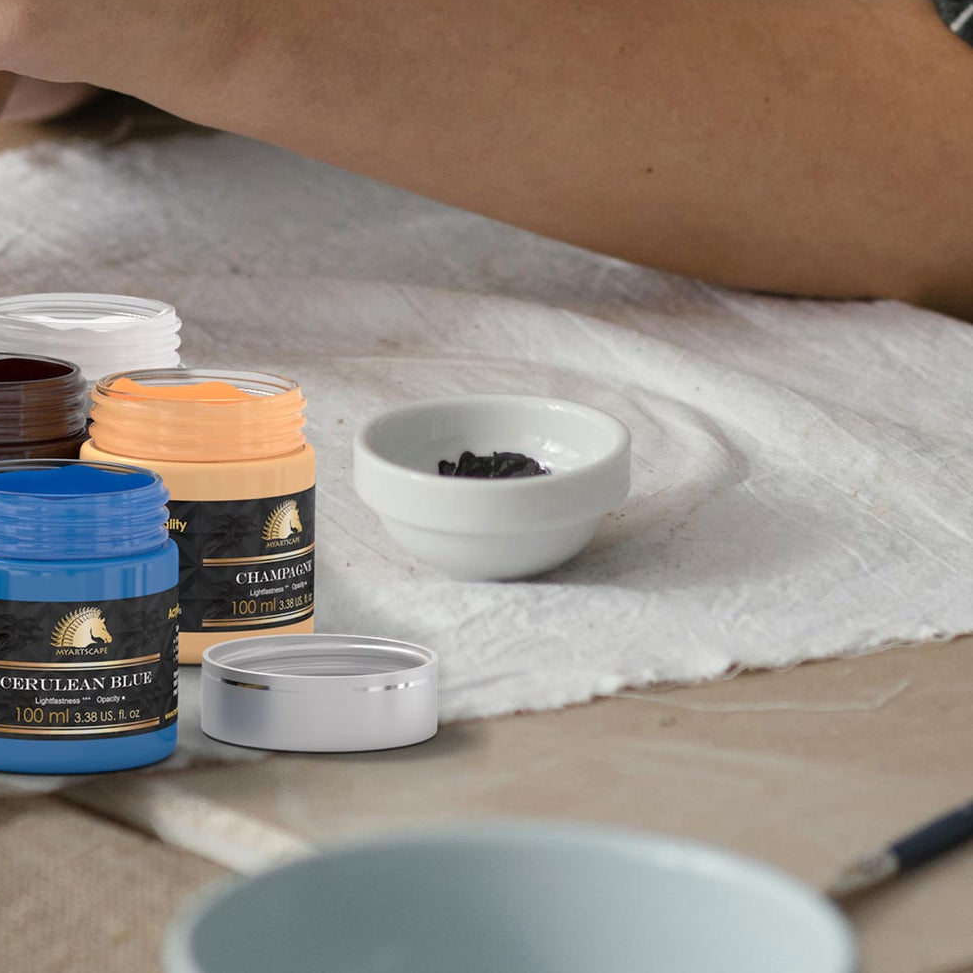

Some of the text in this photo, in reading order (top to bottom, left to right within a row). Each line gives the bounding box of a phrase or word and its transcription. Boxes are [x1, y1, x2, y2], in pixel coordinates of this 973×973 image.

[164, 518, 188, 533] ality
[265, 536, 301, 548] MYARTSCAPE
[250, 586, 284, 598] Lightfastness
[231, 599, 256, 615] 100
[260, 596, 277, 613] ml
[279, 598, 294, 611] 3.38
[55, 646, 109, 656] MYARTSCAPE
[0, 670, 153, 692] CERULEAN BLUE
[34, 694, 120, 706] Lightfastness Opacity
[15, 706, 141, 724] 100 ml 3.38 US. fl. oz
